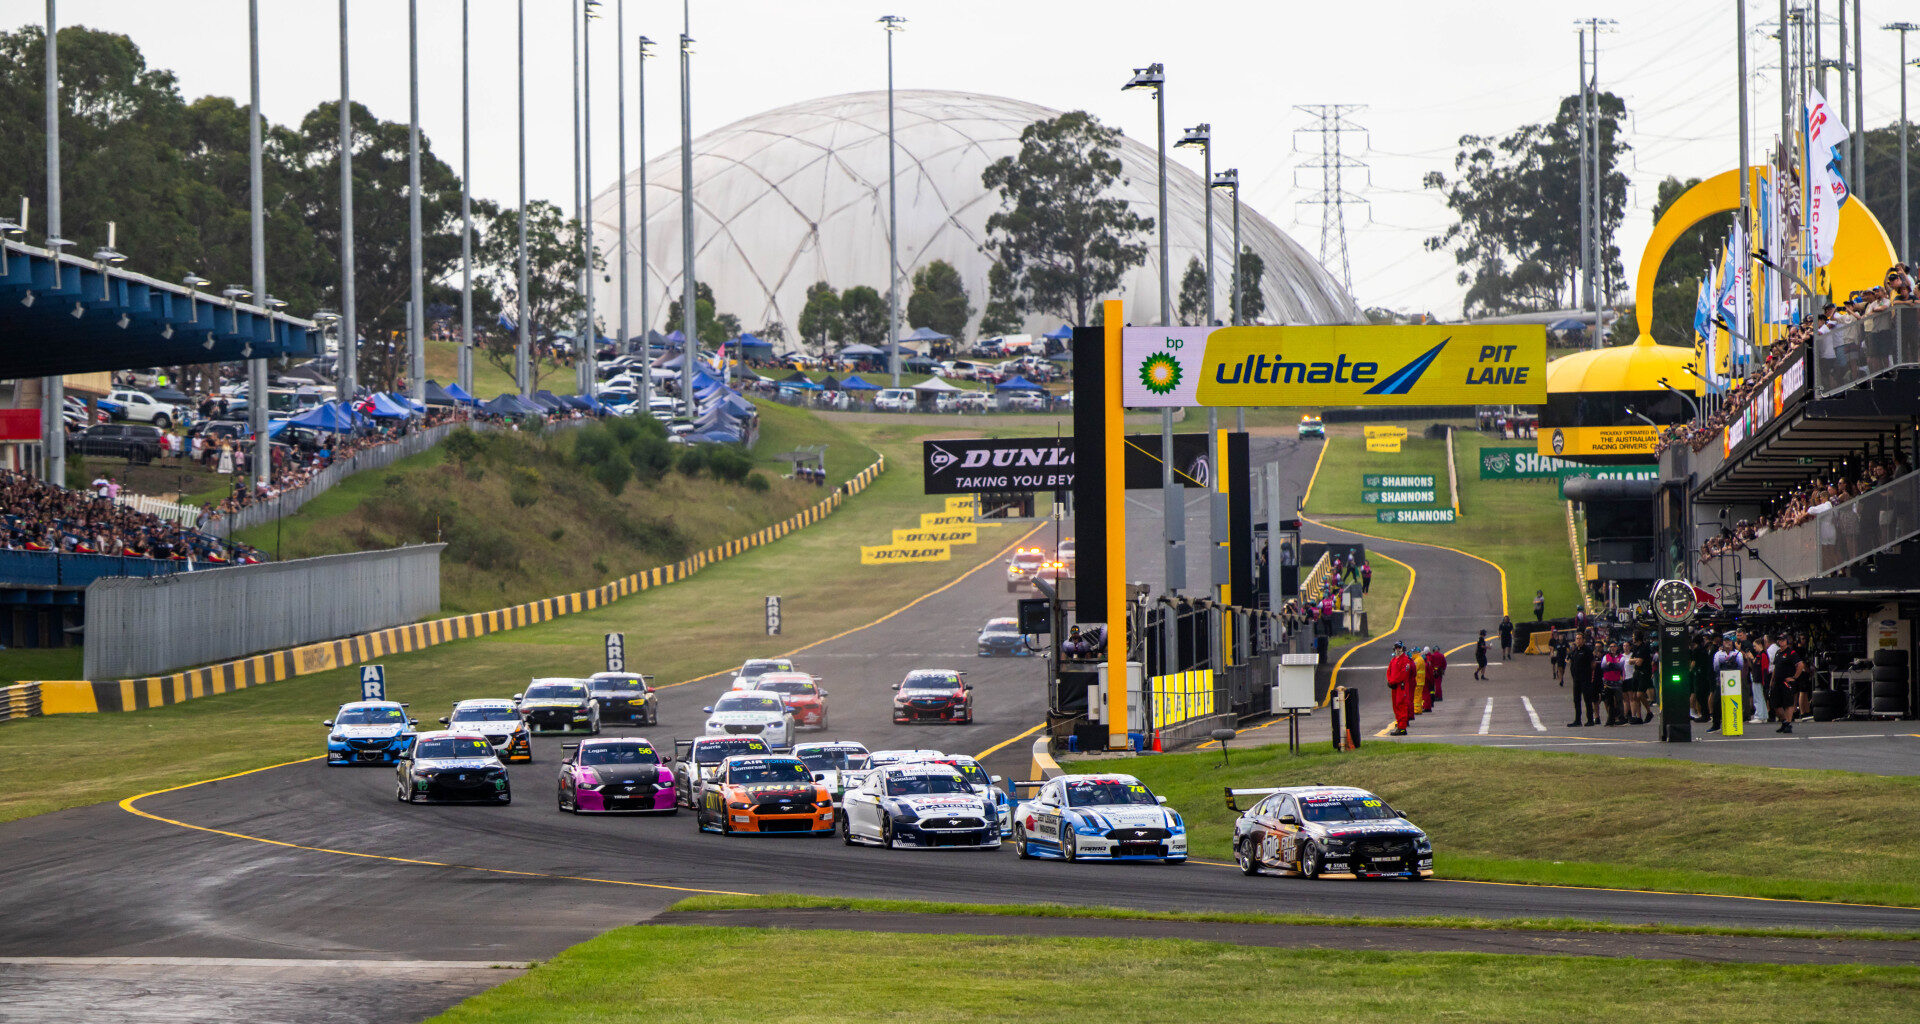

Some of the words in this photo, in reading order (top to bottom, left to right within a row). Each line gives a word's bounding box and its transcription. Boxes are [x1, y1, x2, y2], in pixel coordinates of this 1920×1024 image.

[1166, 336, 1184, 350] bp
[1478, 345, 1517, 363] PIT
[1216, 353, 1379, 385] ultimate
[1465, 367, 1529, 385] LANE
[956, 476, 1008, 488] TAKING
[1012, 475, 1043, 487] YOU
[1382, 477, 1433, 487] SHANNONS
[1381, 491, 1434, 502] SHANNONS
[1397, 510, 1454, 521] SHANNONS
[905, 532, 972, 542] DUNLOP
[874, 548, 944, 559] DUNLOP
[1128, 785, 1146, 793] 78
[1363, 800, 1381, 808] 80
